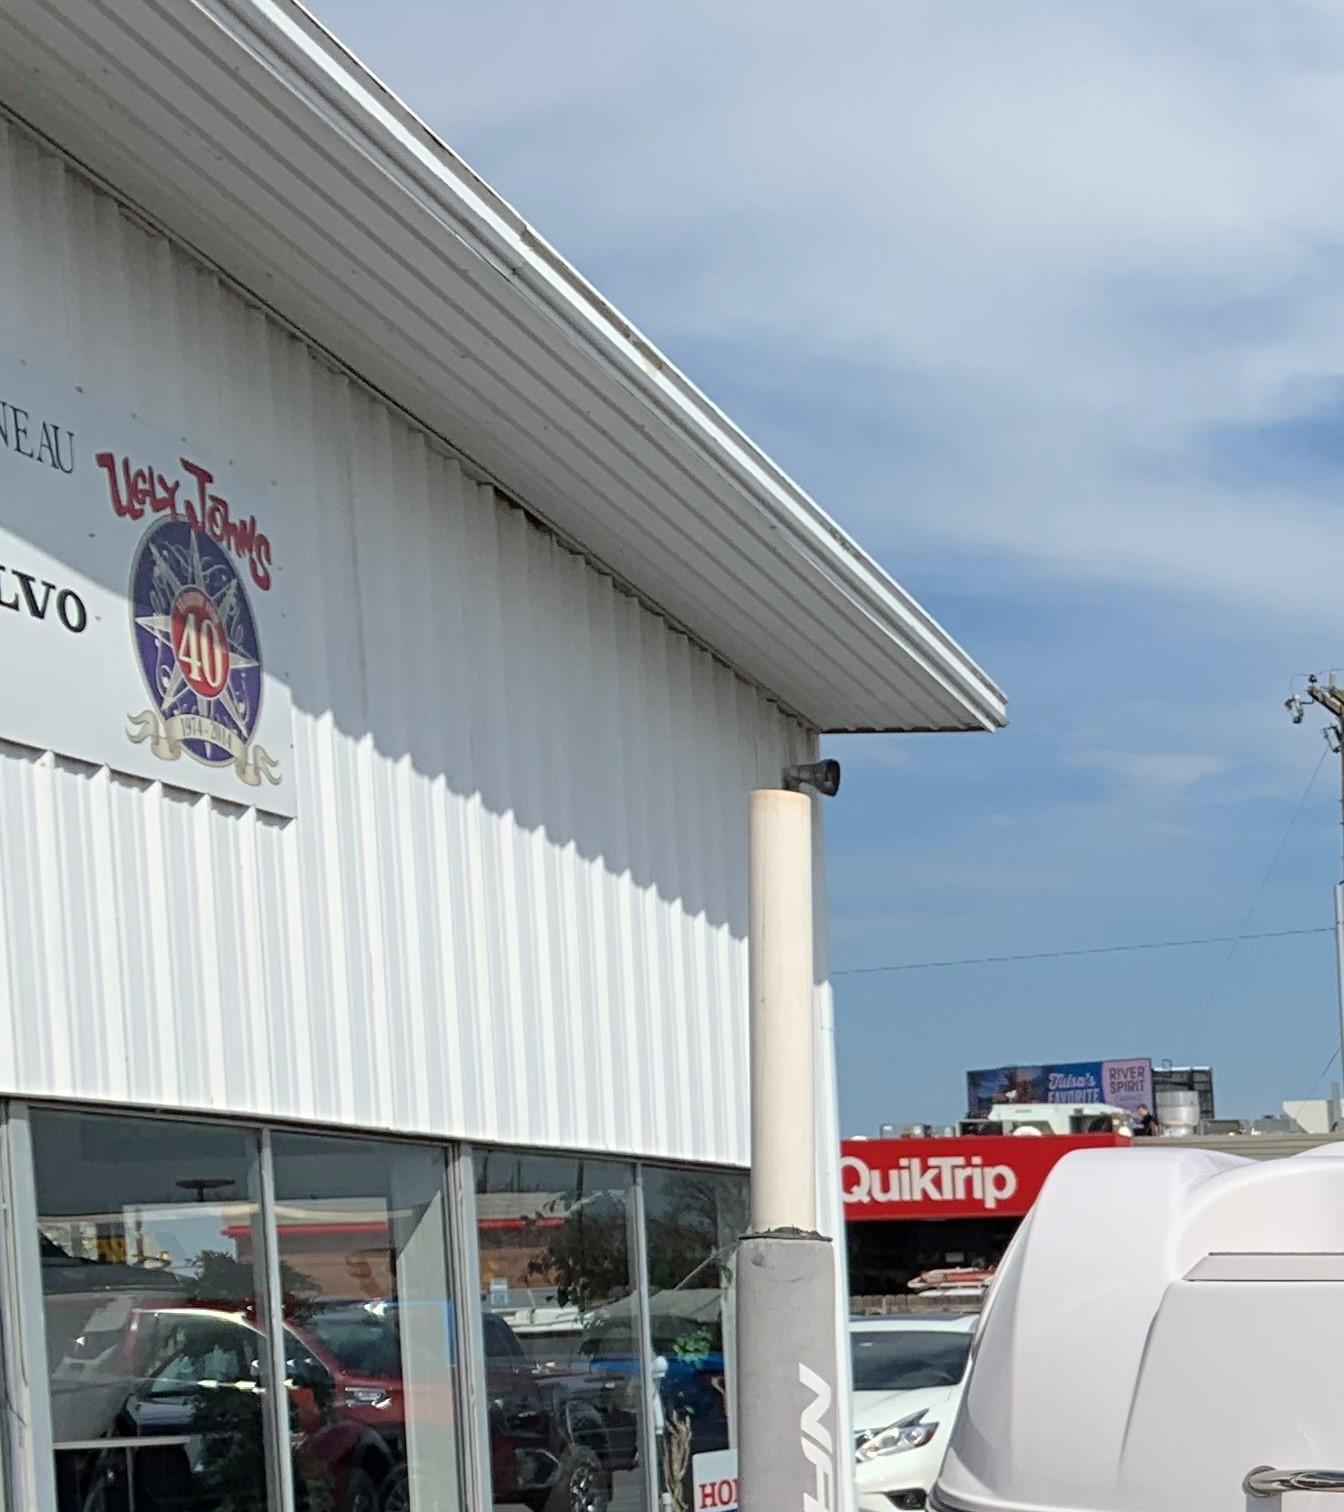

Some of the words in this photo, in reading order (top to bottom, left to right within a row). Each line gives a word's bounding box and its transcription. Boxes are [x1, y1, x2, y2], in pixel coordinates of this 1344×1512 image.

[96, 452, 180, 521] UGLY
[178, 613, 223, 688] 40
[1048, 1072, 1097, 1090] Tulsa's
[1108, 1065, 1145, 1080] RIVER
[1047, 1087, 1100, 1104] FAVORITE
[1109, 1080, 1145, 1095] SPIRIT
[841, 1155, 1017, 1209] QuikTrip
